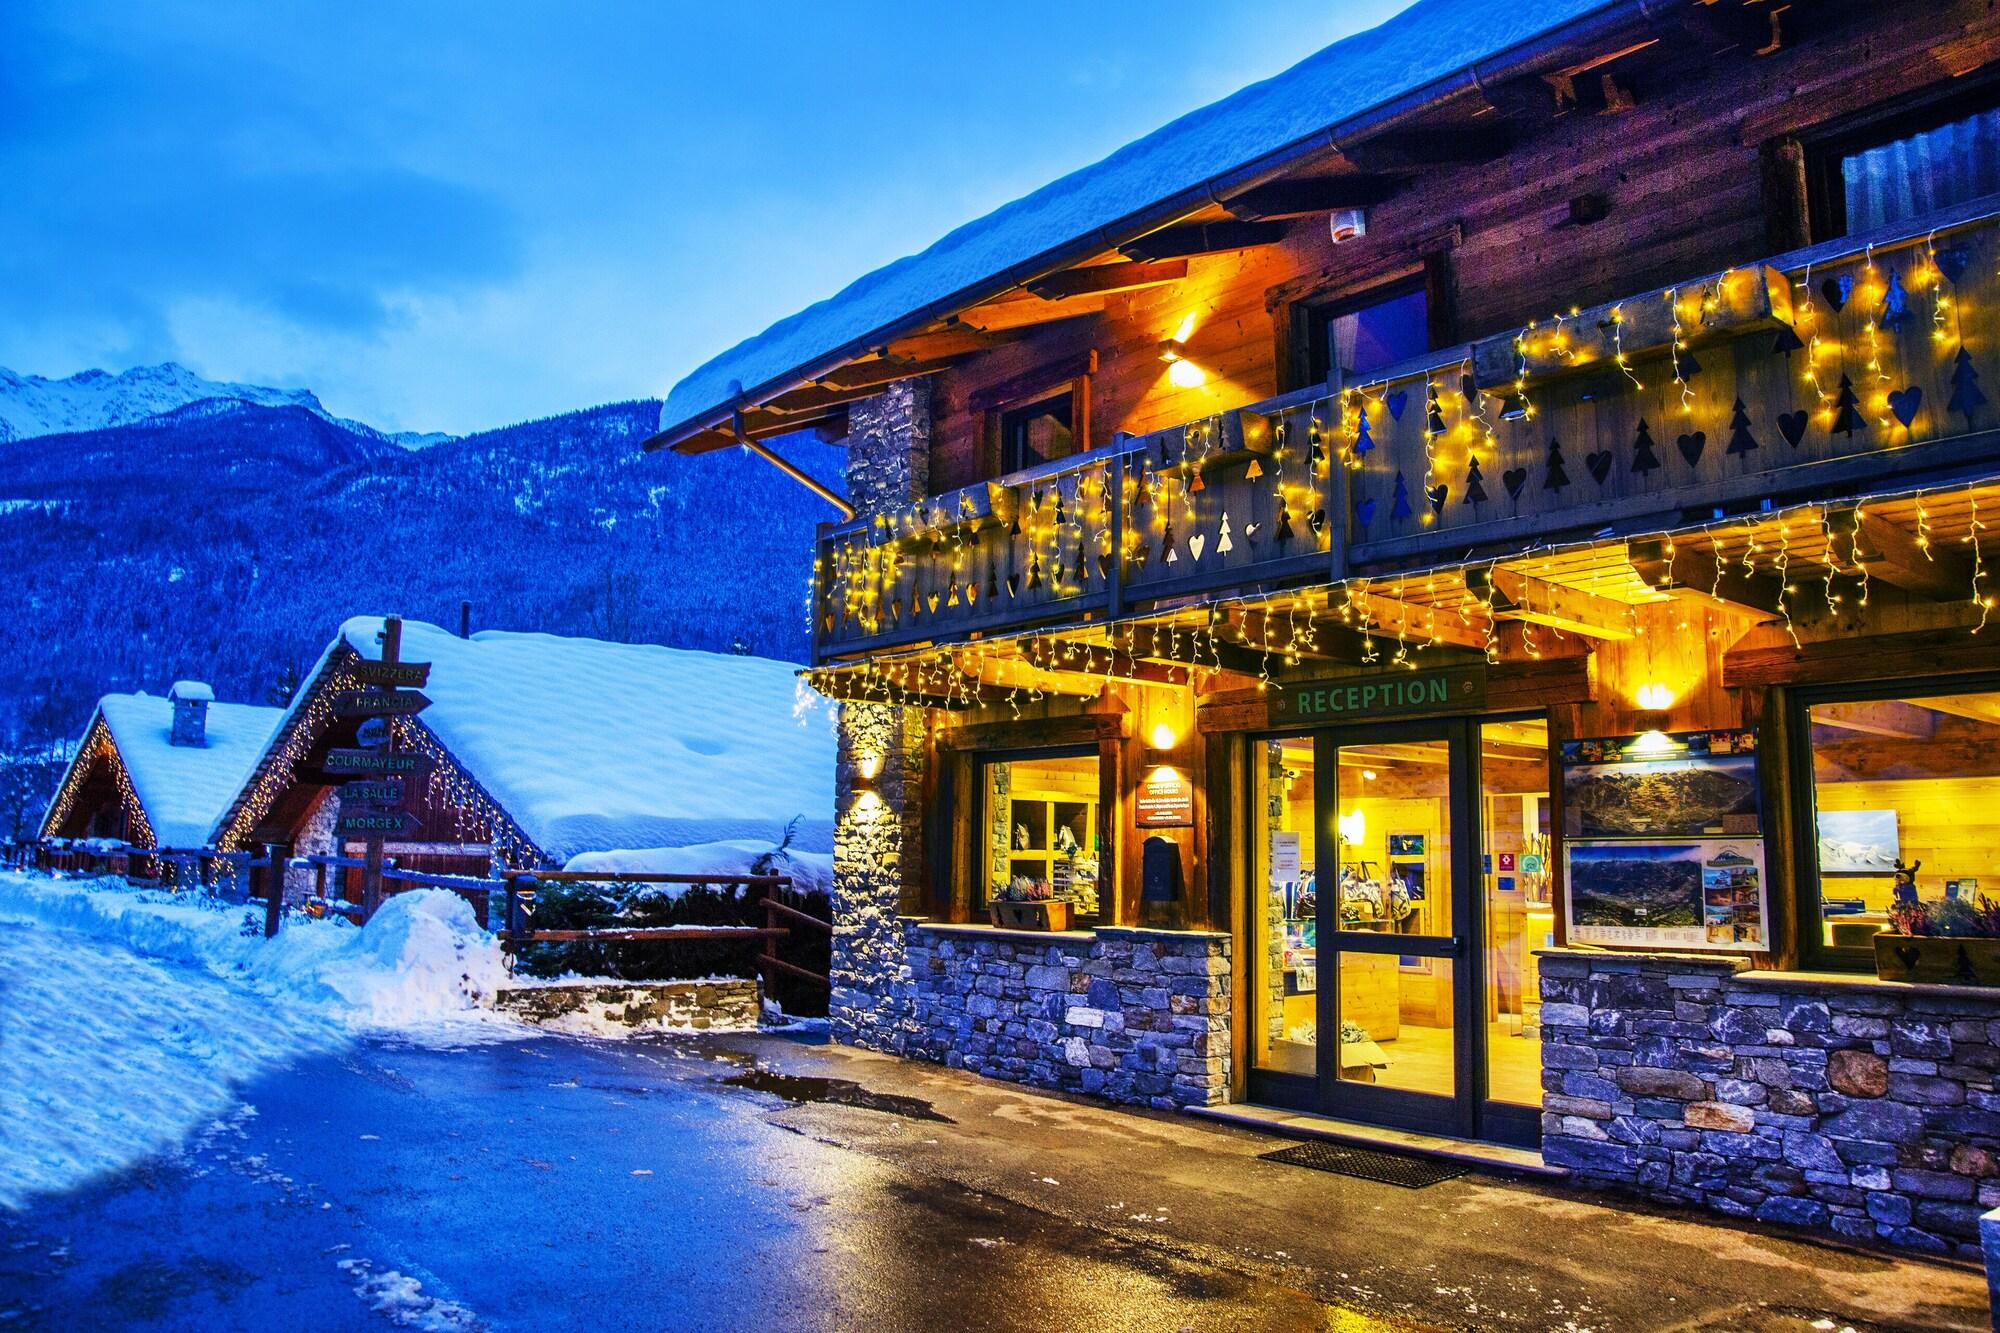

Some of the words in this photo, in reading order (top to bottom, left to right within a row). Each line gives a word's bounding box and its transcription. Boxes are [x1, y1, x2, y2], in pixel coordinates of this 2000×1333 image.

[361, 667, 423, 680] SVIZZERA
[1297, 678, 1448, 714] RECEPTION
[356, 698, 414, 709] FRANCIA
[327, 755, 415, 770] COURMAYEUR
[344, 787, 359, 799] LA
[362, 787, 398, 799] SALLE
[345, 817, 402, 829] MORGEX
